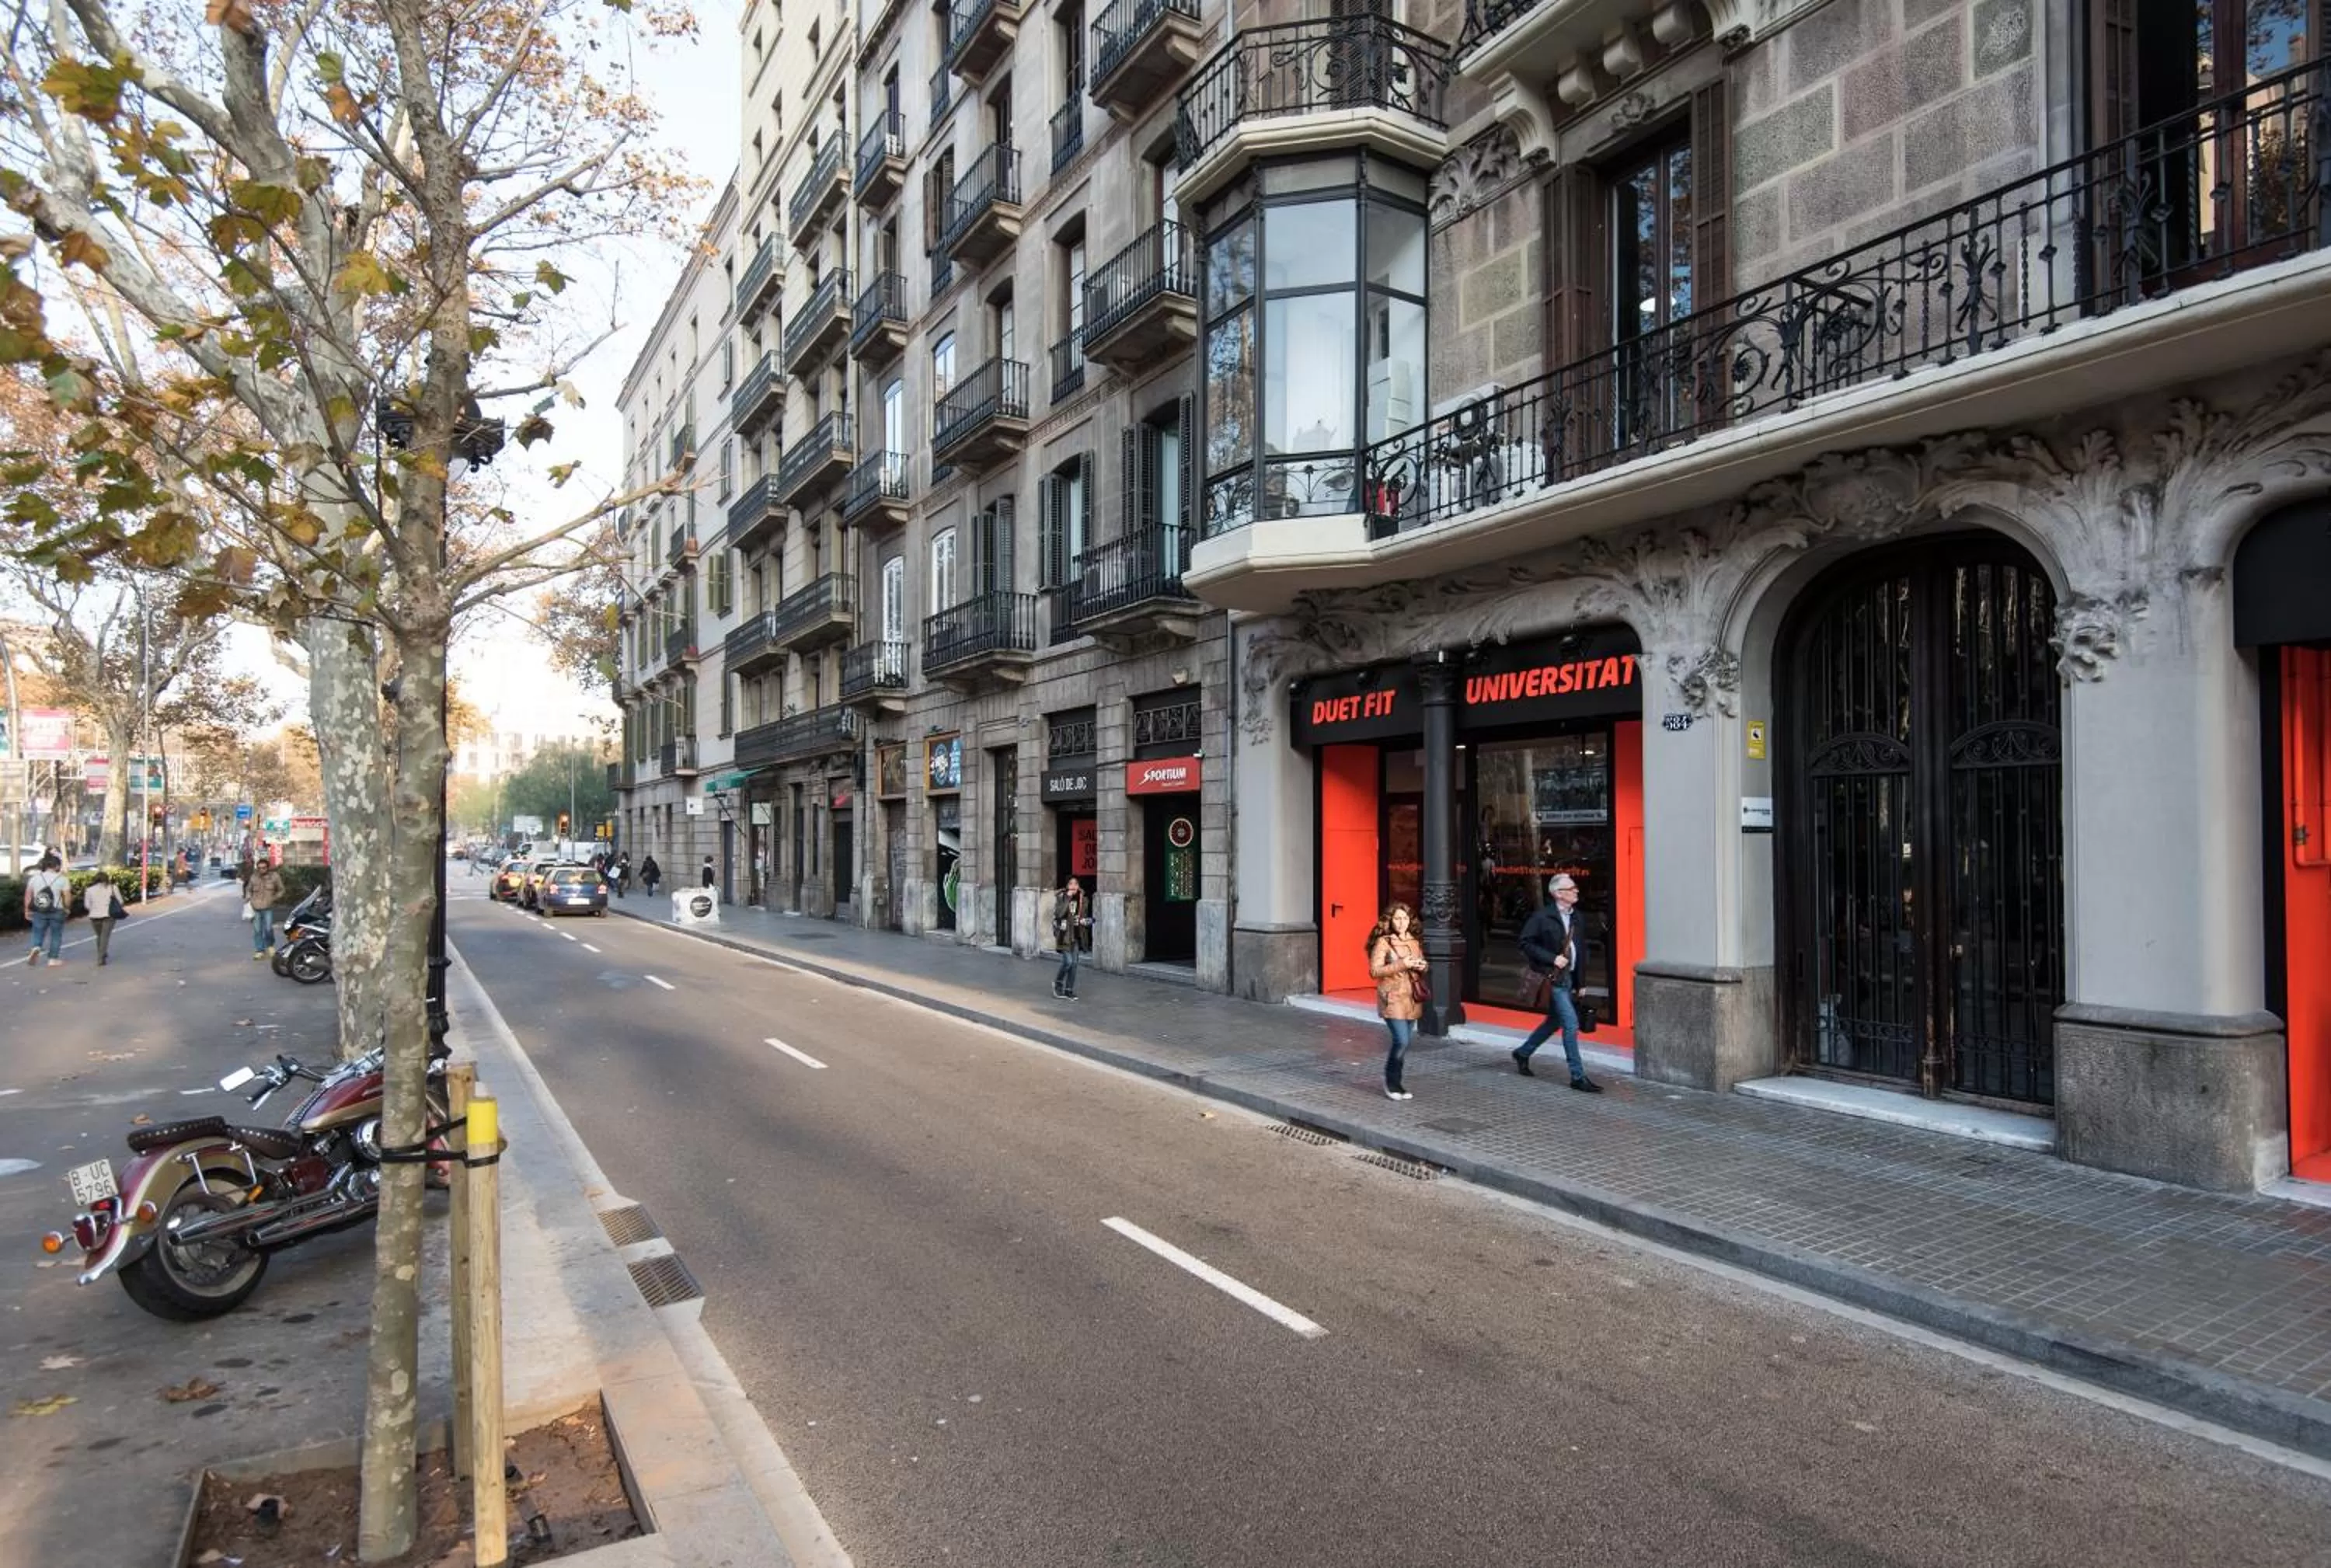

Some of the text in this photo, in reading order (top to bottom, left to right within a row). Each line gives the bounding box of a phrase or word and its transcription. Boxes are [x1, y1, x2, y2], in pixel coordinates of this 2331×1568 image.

[1466, 655, 1636, 706] UNIVERSITAT
[1312, 689, 1396, 725] DUET FIT
[1065, 778, 1074, 791] DE
[1075, 776, 1087, 790] JOC
[1140, 767, 1186, 785] SPORTIUM
[1078, 829, 1097, 841] SAL
[1082, 856, 1096, 869] JO
[76, 1179, 113, 1204] 5796
